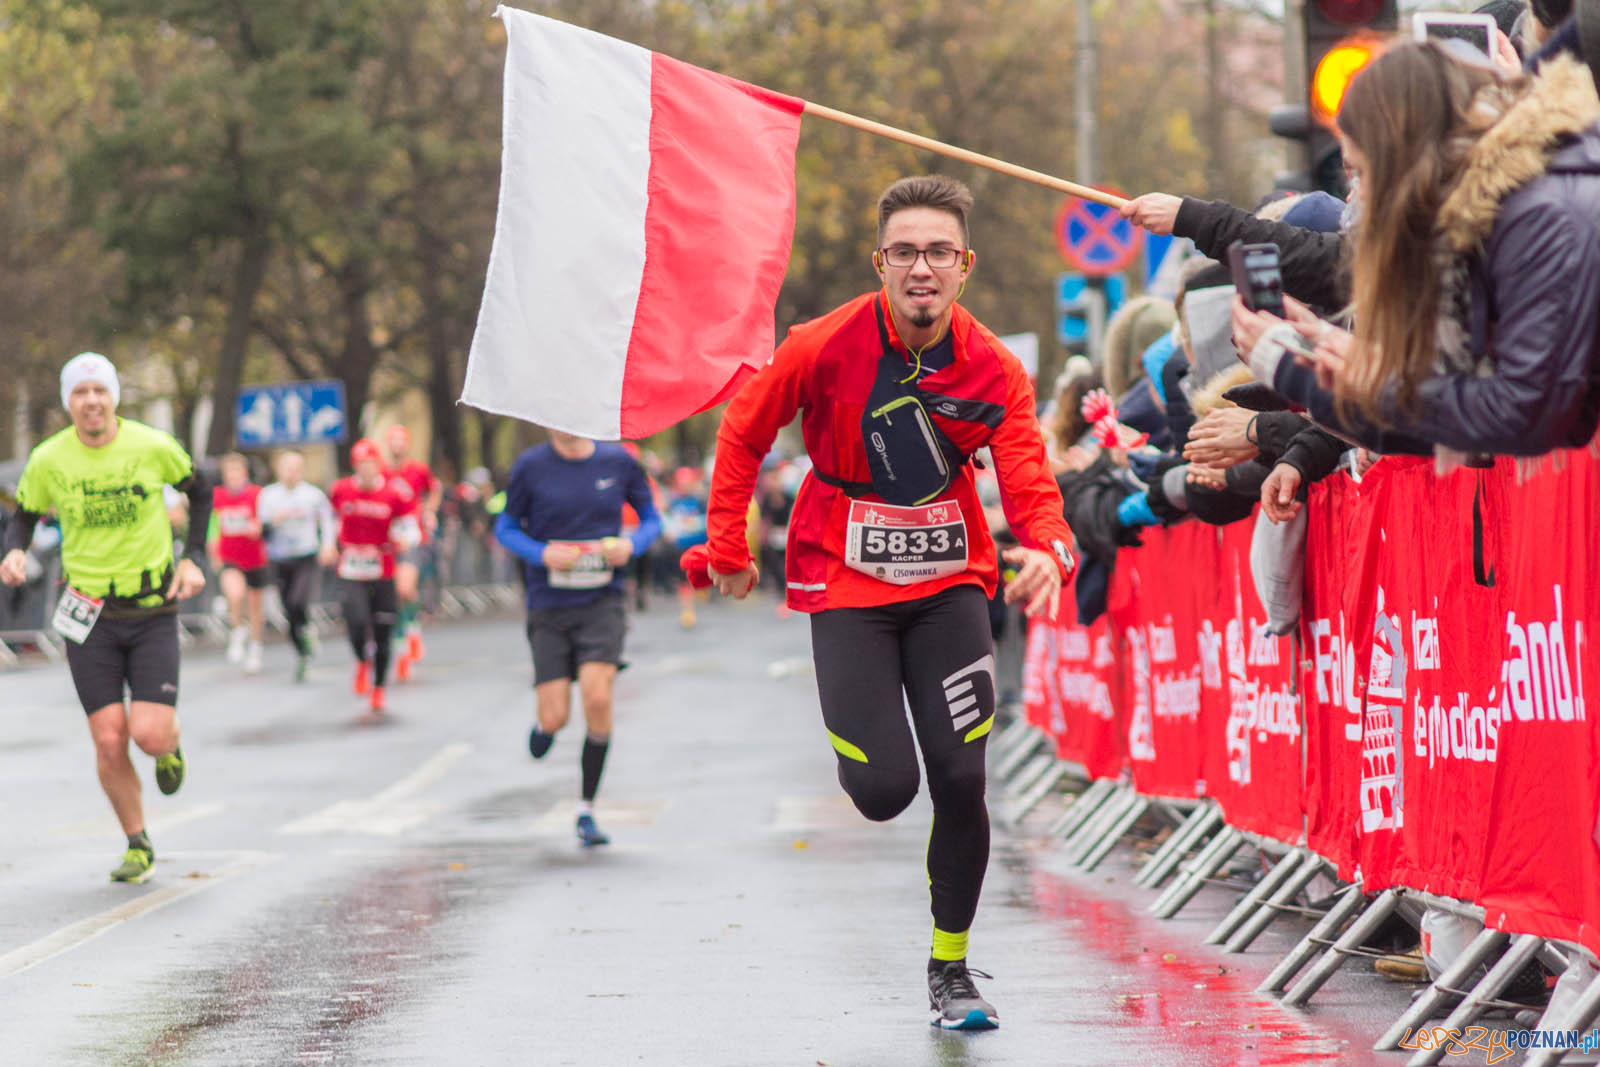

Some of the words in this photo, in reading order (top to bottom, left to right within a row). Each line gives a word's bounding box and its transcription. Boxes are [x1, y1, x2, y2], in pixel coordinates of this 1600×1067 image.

[865, 529, 950, 554] 5833
[955, 537, 964, 548] A
[891, 555, 924, 563] KACPER
[893, 567, 937, 579] CISOWIANKA
